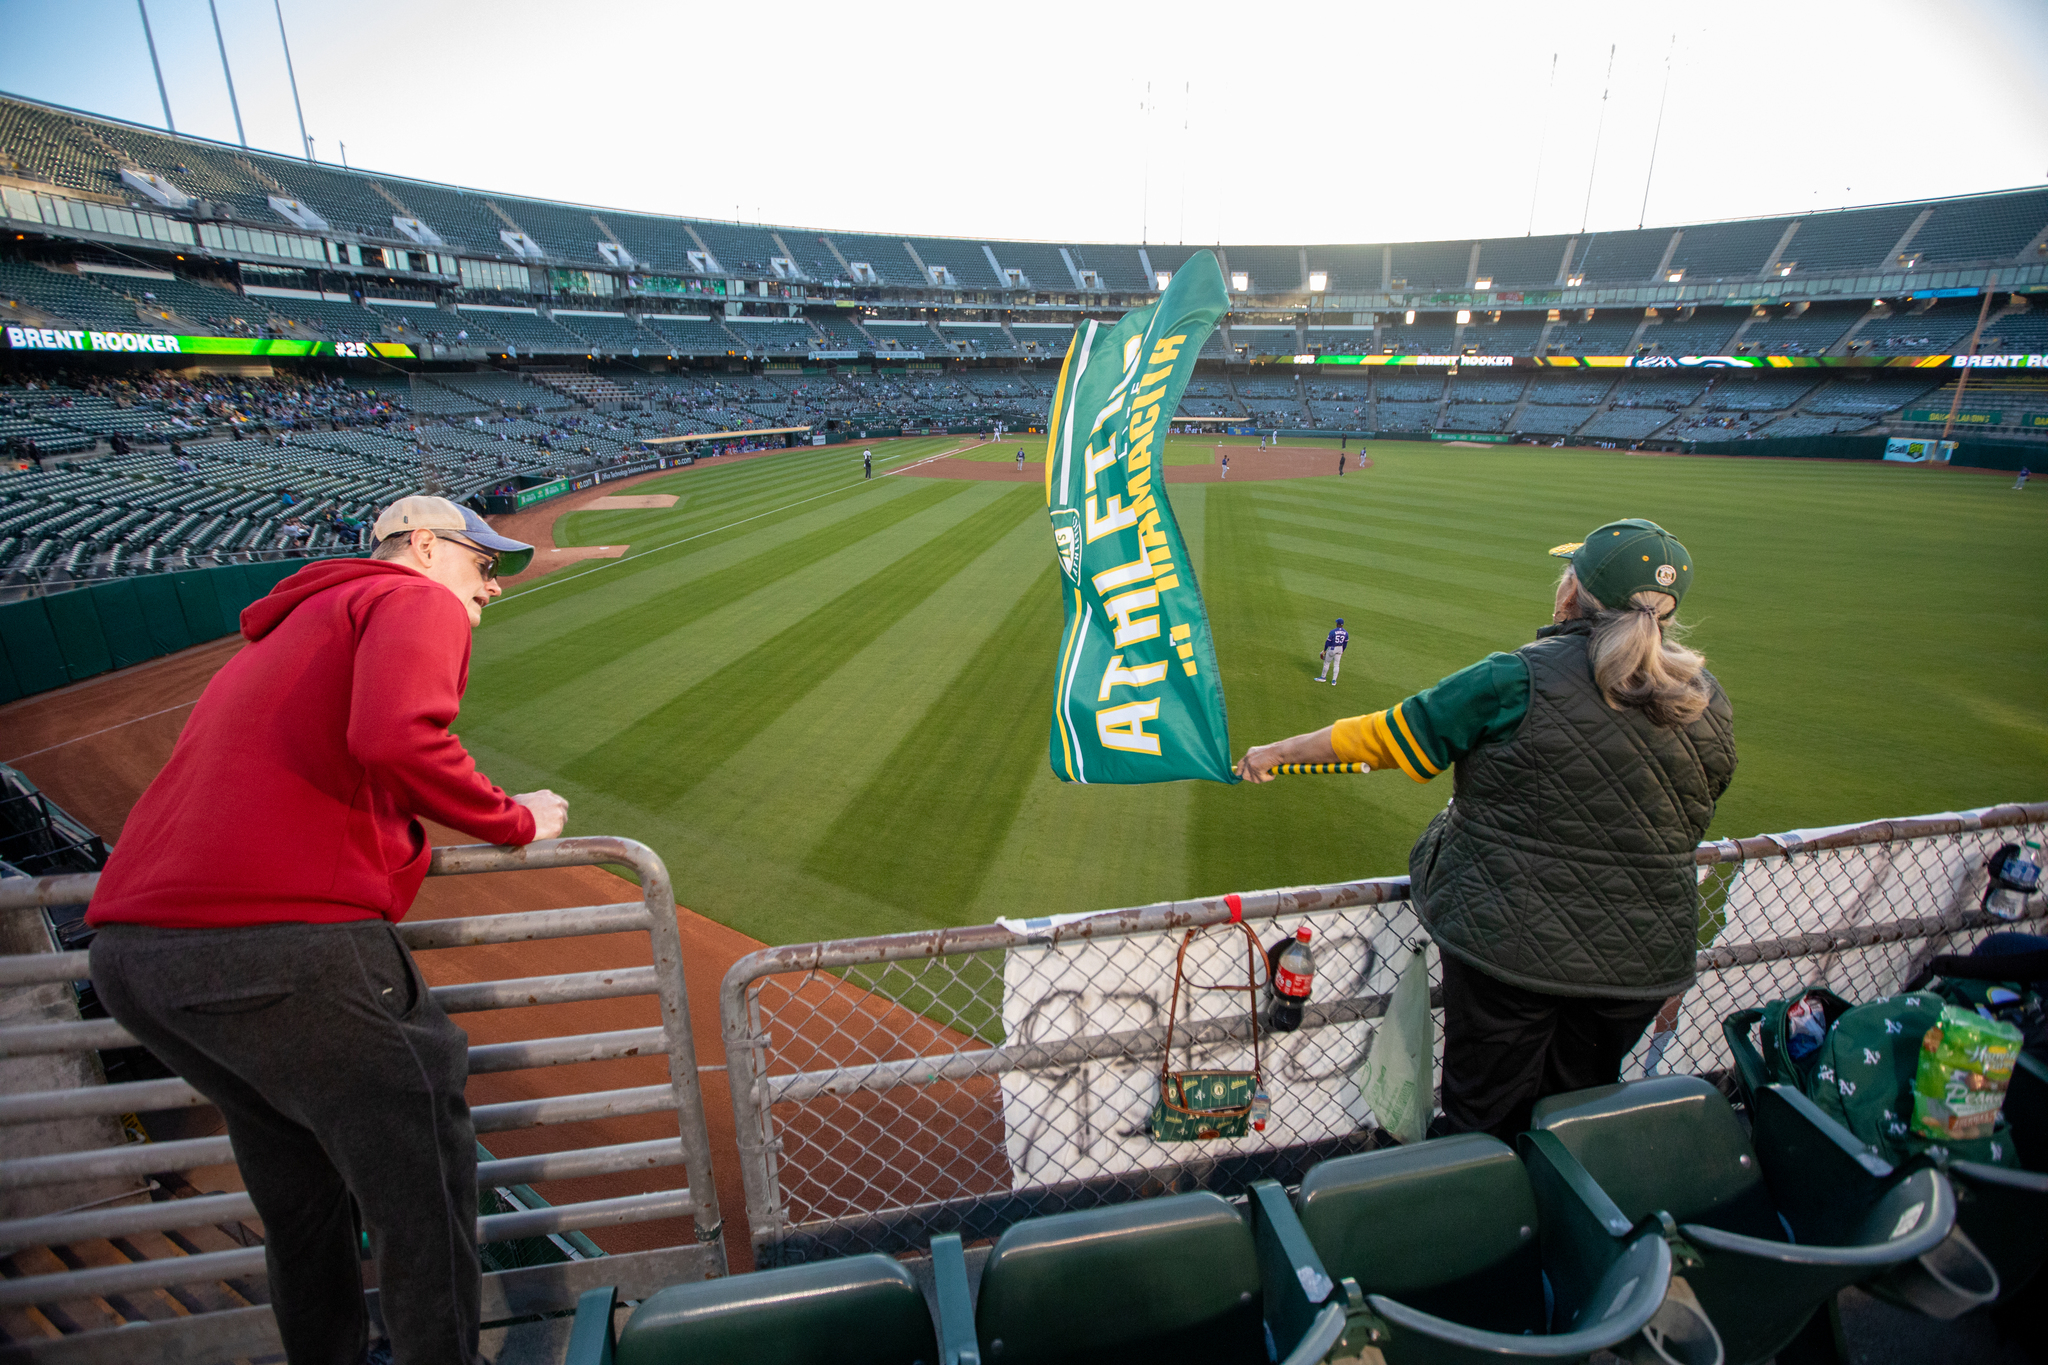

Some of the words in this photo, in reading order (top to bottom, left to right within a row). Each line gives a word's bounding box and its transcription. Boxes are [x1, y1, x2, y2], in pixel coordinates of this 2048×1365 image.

[7, 327, 85, 350] BRENT
[89, 331, 182, 353] ROOKER
[335, 342, 368, 358] #25
[1417, 355, 1459, 366] BRENT
[1460, 355, 1514, 367] ROOKER
[1952, 355, 2023, 368] BRENT
[1334, 635, 1346, 643] 53
